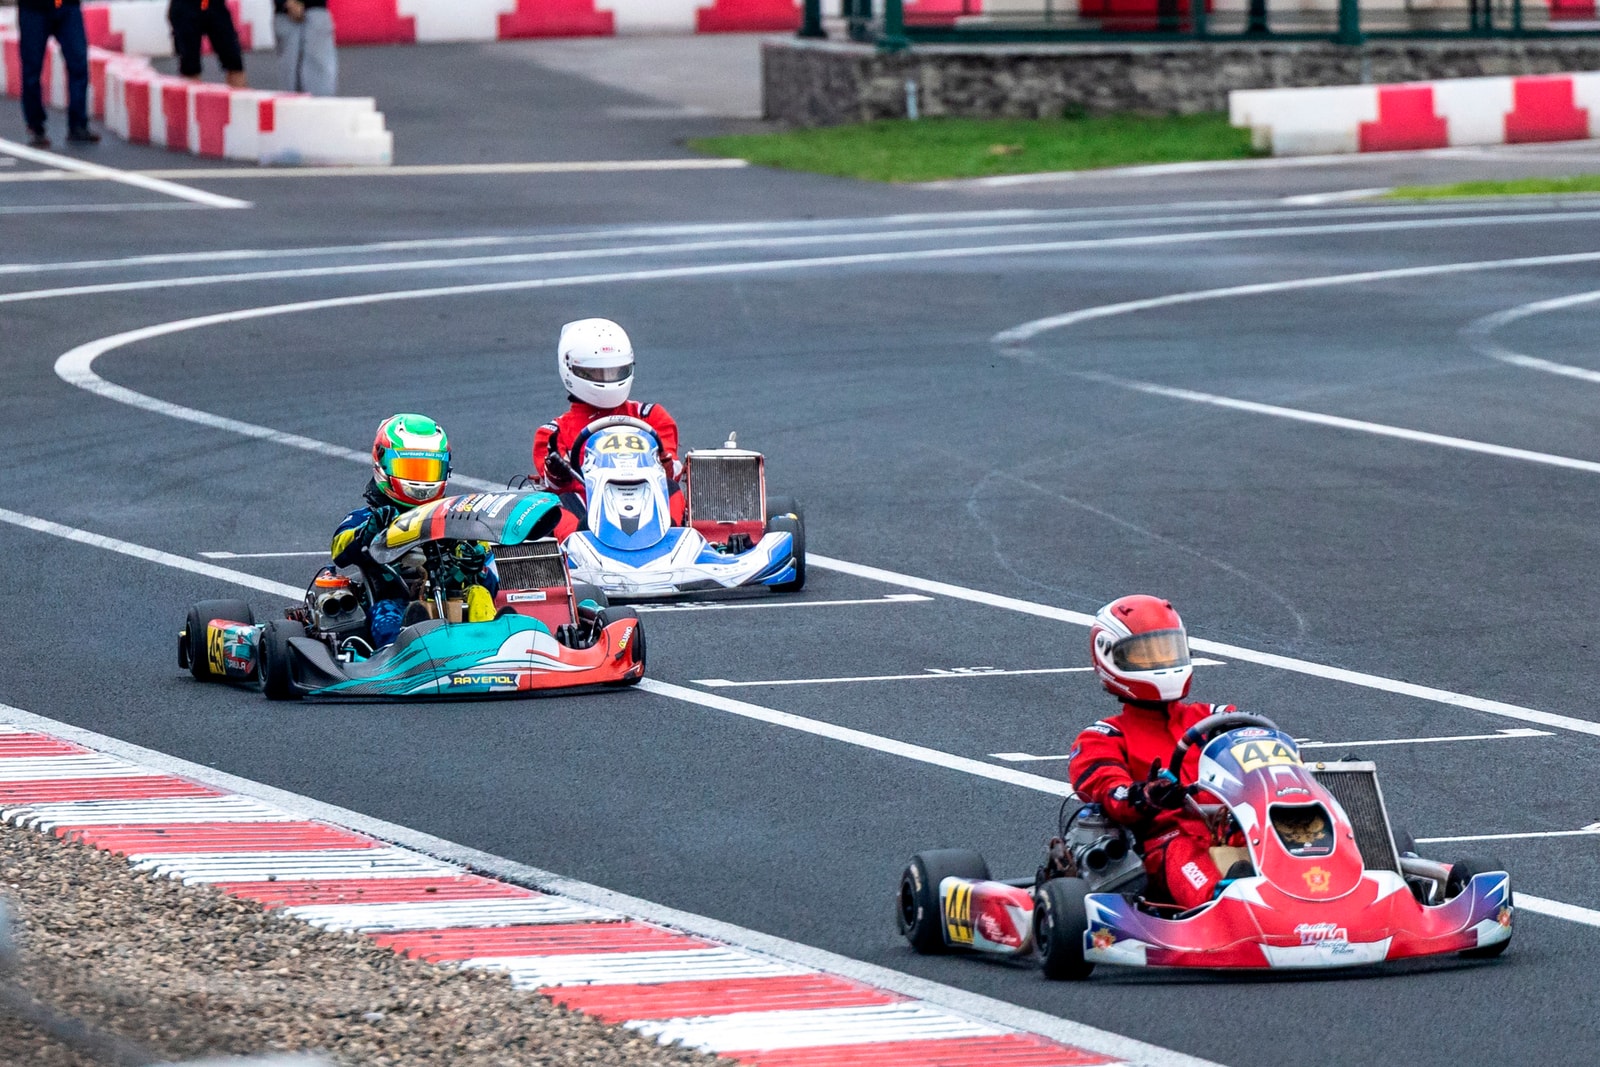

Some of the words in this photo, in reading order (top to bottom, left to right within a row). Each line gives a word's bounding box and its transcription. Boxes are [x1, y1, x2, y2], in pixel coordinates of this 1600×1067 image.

[602, 435, 645, 451] 48
[210, 628, 225, 674] 45
[453, 676, 514, 685] RAVENOL
[1242, 742, 1299, 764] 44
[948, 884, 973, 936] 44
